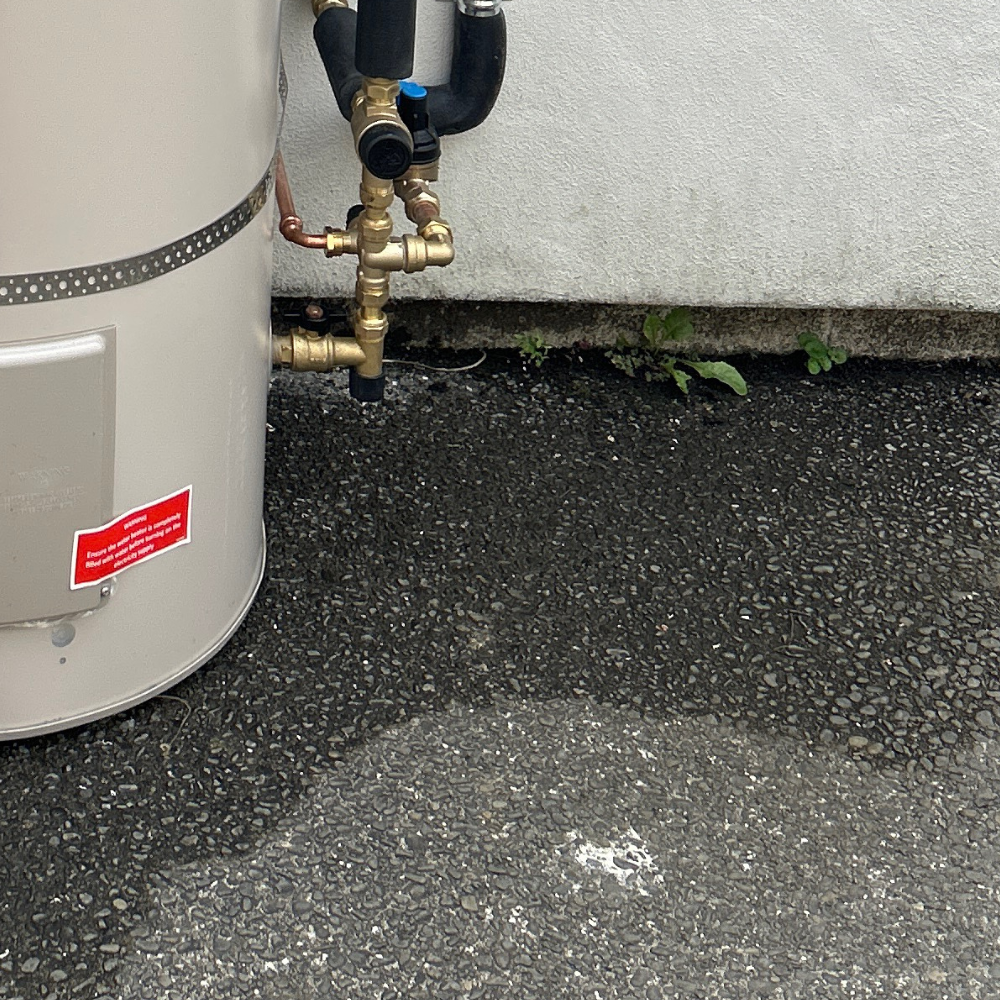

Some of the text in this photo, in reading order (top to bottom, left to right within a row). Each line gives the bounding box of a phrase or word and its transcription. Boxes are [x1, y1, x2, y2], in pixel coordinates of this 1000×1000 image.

[87, 512, 181, 559] Ensure the water heater is completely
[102, 553, 114, 564] with
[114, 546, 128, 558] water
[129, 538, 145, 551] before
[145, 530, 164, 542] turning
[164, 526, 172, 535] on
[172, 522, 181, 531] the
[137, 543, 155, 556] supply
